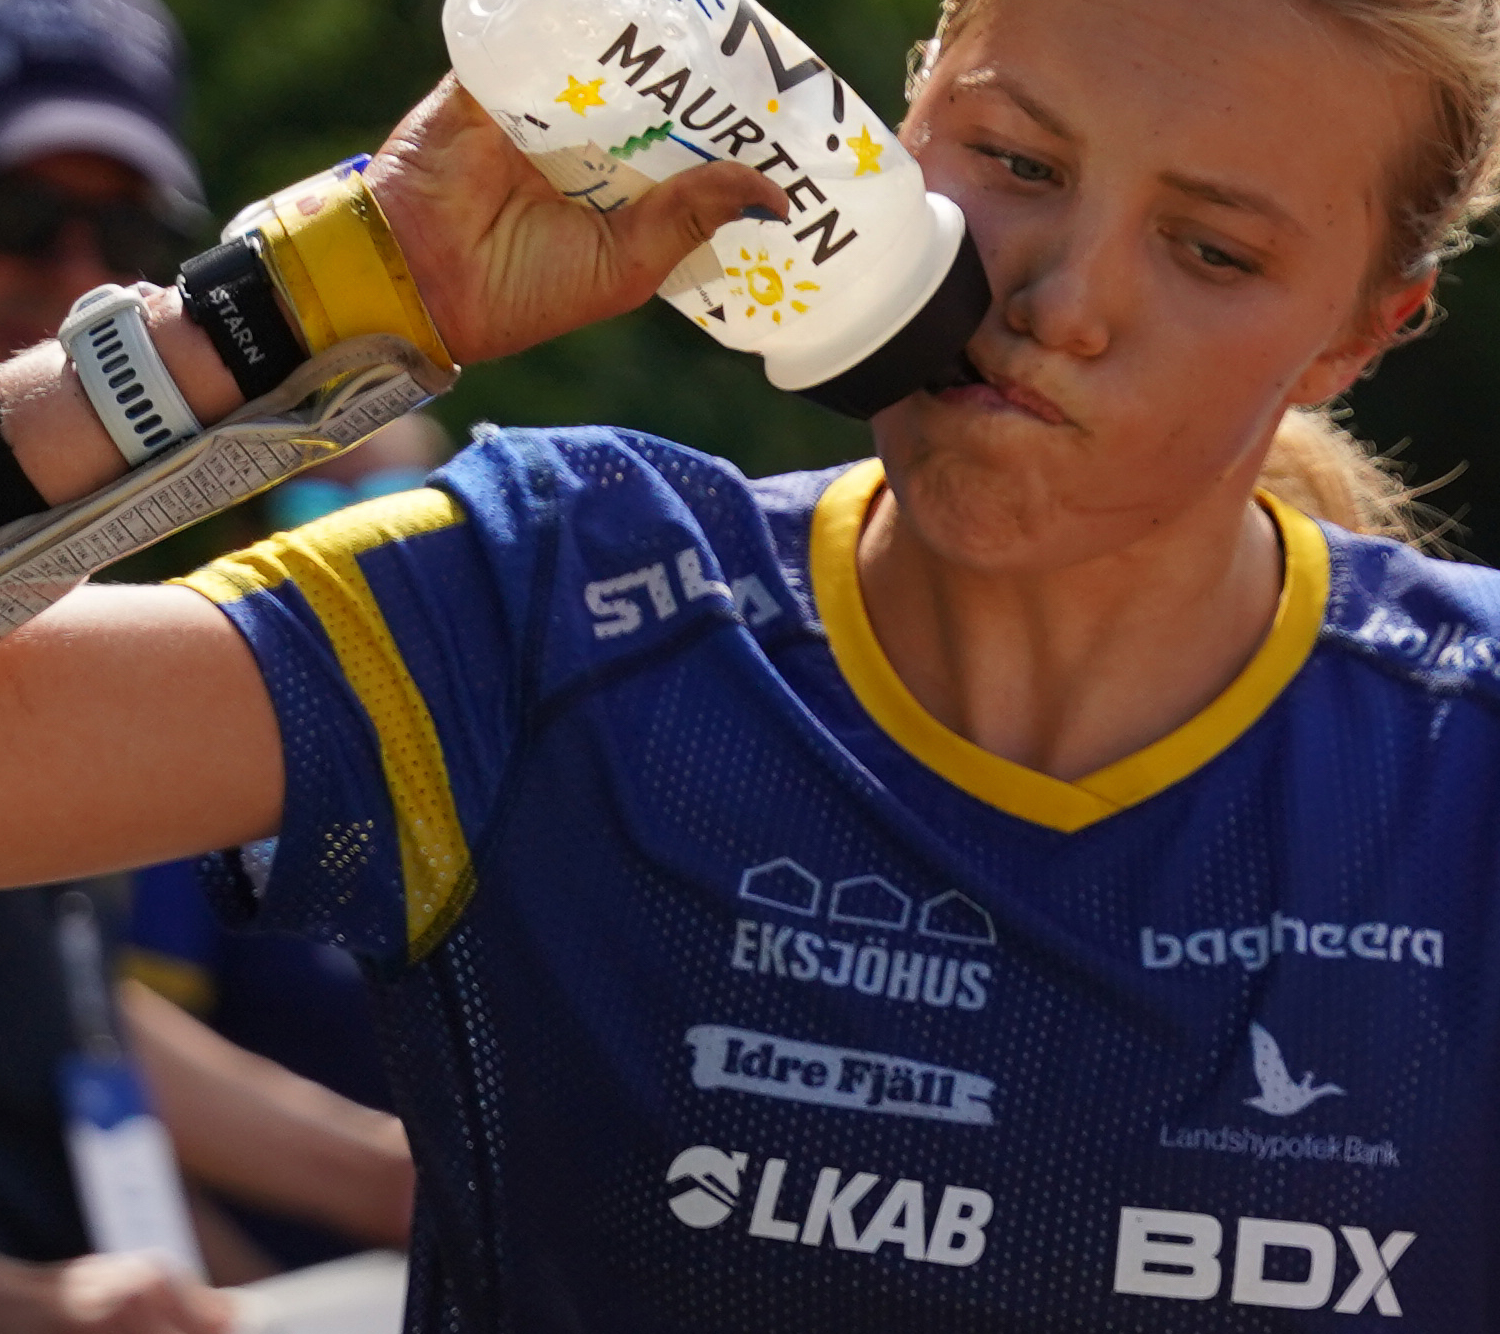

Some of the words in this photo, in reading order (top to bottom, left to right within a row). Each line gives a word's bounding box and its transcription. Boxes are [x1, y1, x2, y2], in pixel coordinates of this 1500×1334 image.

[598, 23, 857, 266] MAURTEN
[584, 547, 783, 640] SILA
[732, 919, 993, 1011] EKSJÖHUS
[1141, 911, 1444, 969] bagheera
[723, 1038, 829, 1086] Idre
[835, 1057, 955, 1106] Fjäll
[1344, 1134, 1400, 1167] Bank
[748, 1158, 993, 1266] LKAB
[1113, 1206, 1418, 1317] BDX
